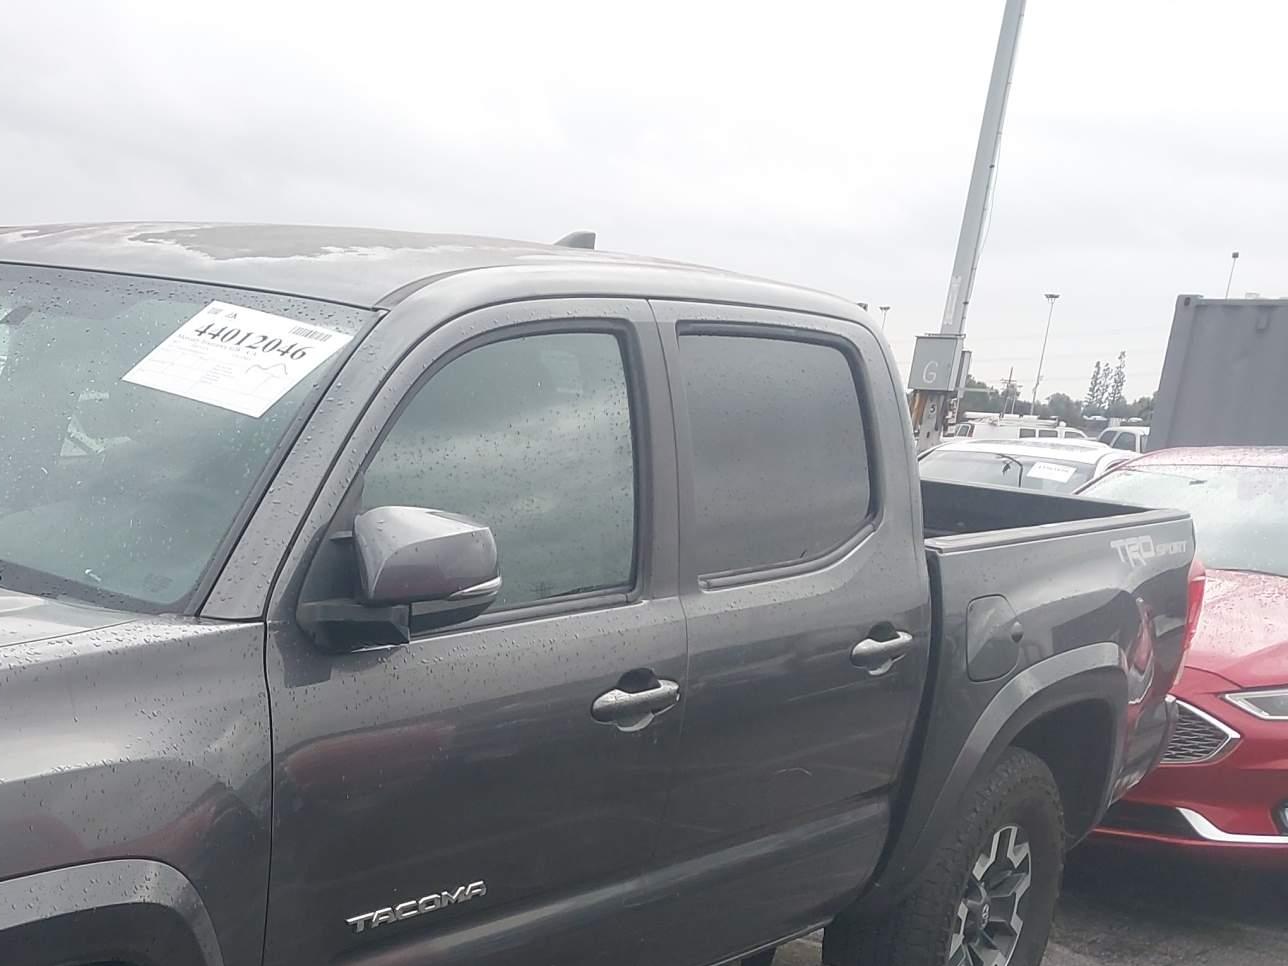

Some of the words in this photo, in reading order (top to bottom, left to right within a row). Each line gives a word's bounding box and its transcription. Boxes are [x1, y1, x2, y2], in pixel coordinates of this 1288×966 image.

[194, 323, 313, 361] 44012046
[922, 360, 938, 384] G
[1110, 535, 1155, 568] TRD
[1155, 540, 1188, 557] SPORT
[345, 880, 488, 934] TACOMA
